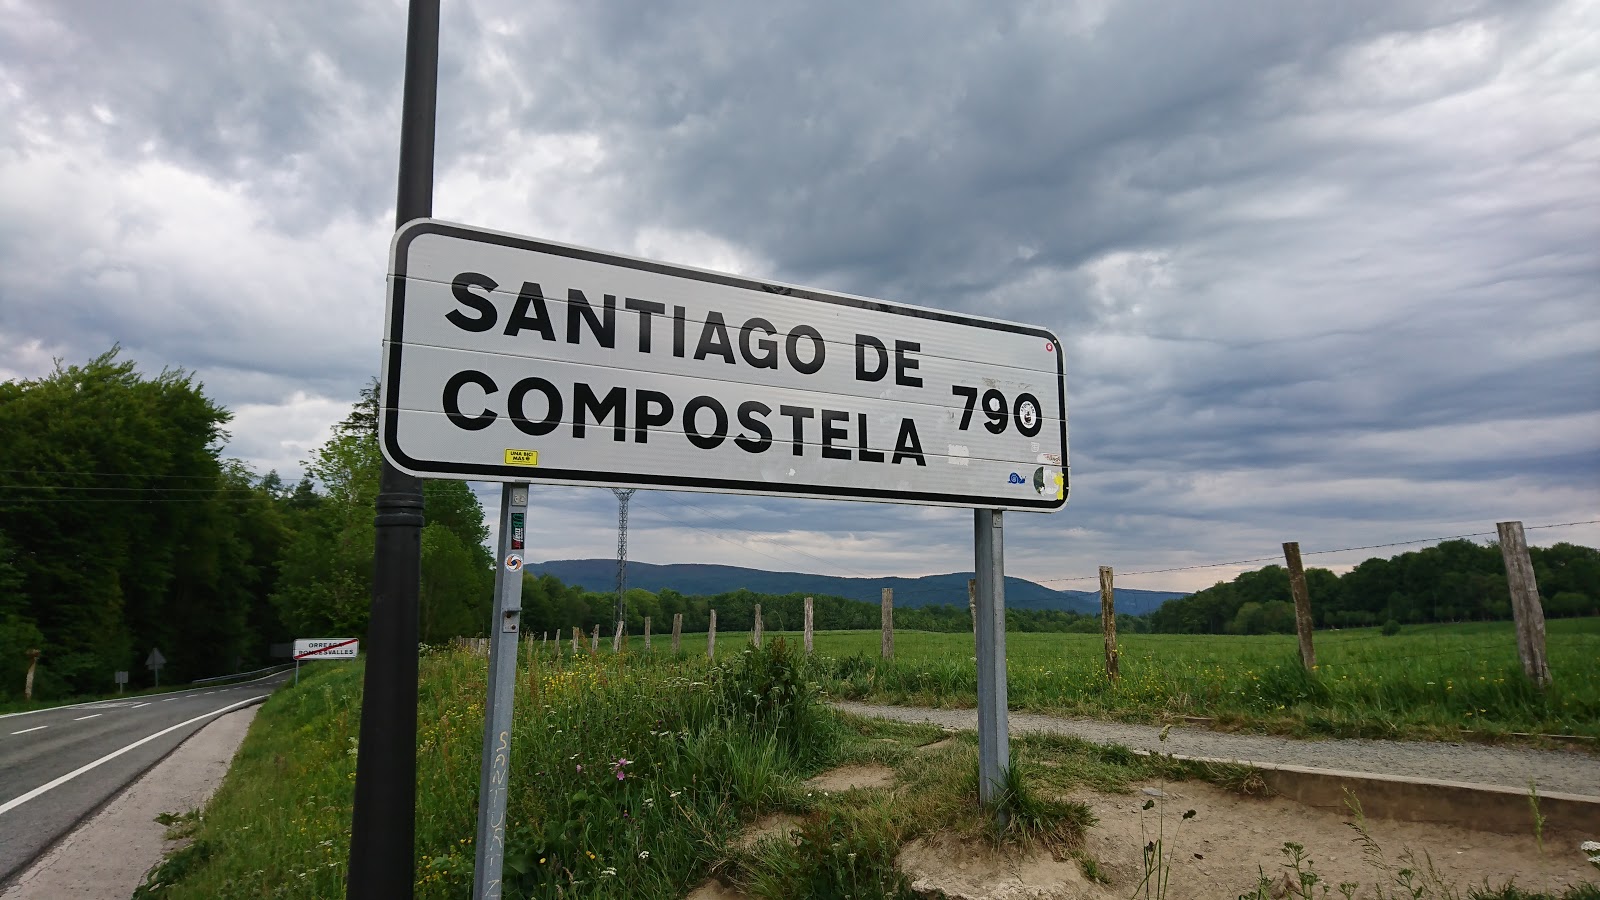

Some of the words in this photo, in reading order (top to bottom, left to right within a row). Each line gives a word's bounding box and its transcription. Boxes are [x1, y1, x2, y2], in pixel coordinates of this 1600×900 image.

[445, 272, 825, 374] SANTIAGO
[855, 334, 923, 388] DE
[443, 370, 926, 466] COMPOSTELA
[952, 385, 1042, 437] 790
